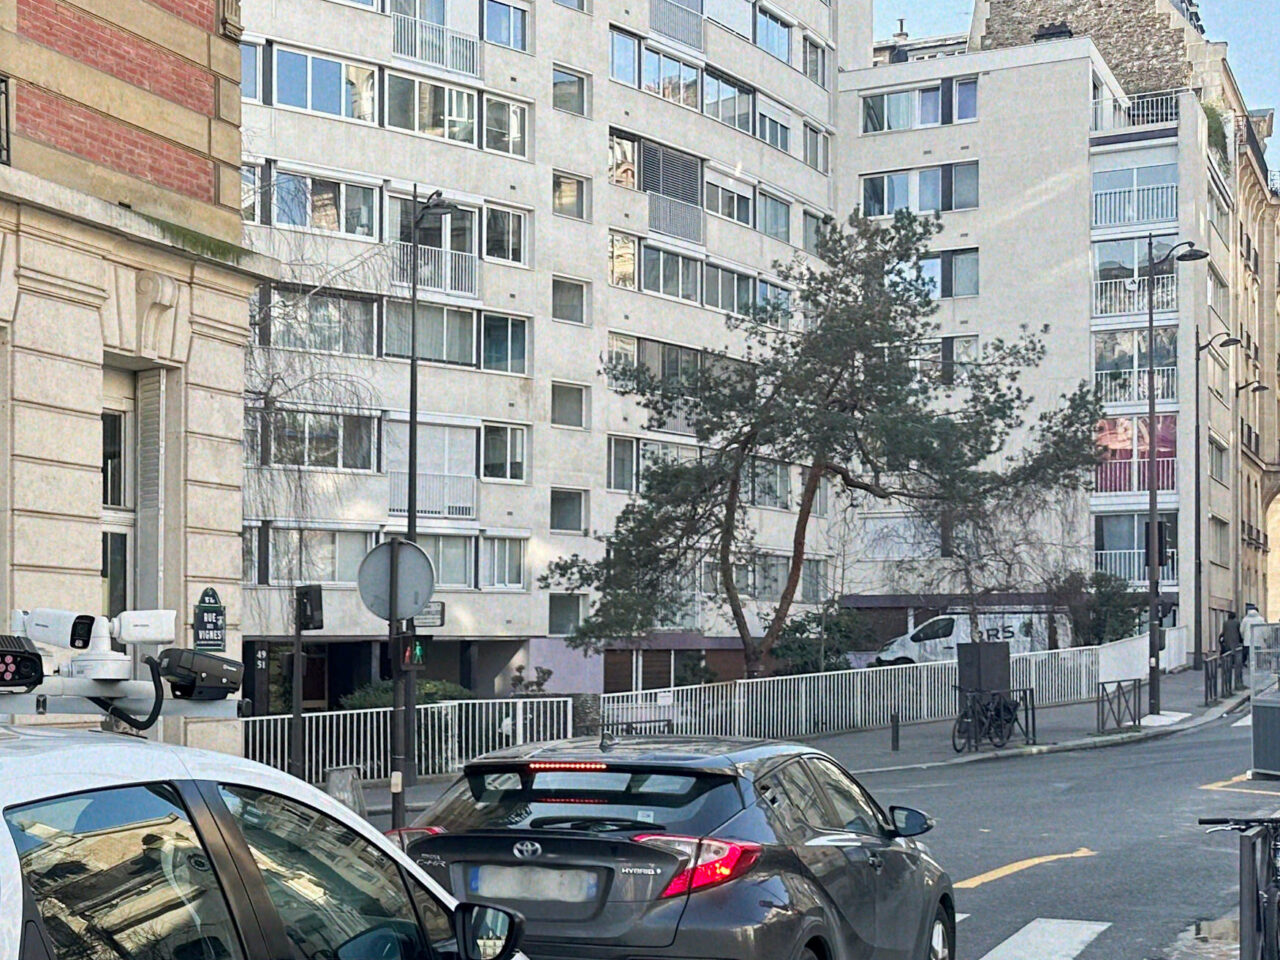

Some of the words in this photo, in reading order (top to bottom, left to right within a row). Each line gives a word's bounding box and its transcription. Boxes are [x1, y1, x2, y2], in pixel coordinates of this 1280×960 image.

[203, 613, 216, 622] RUE
[198, 630, 222, 640] VIGNES
[256, 650, 266, 659] 49
[257, 660, 266, 669] 51
